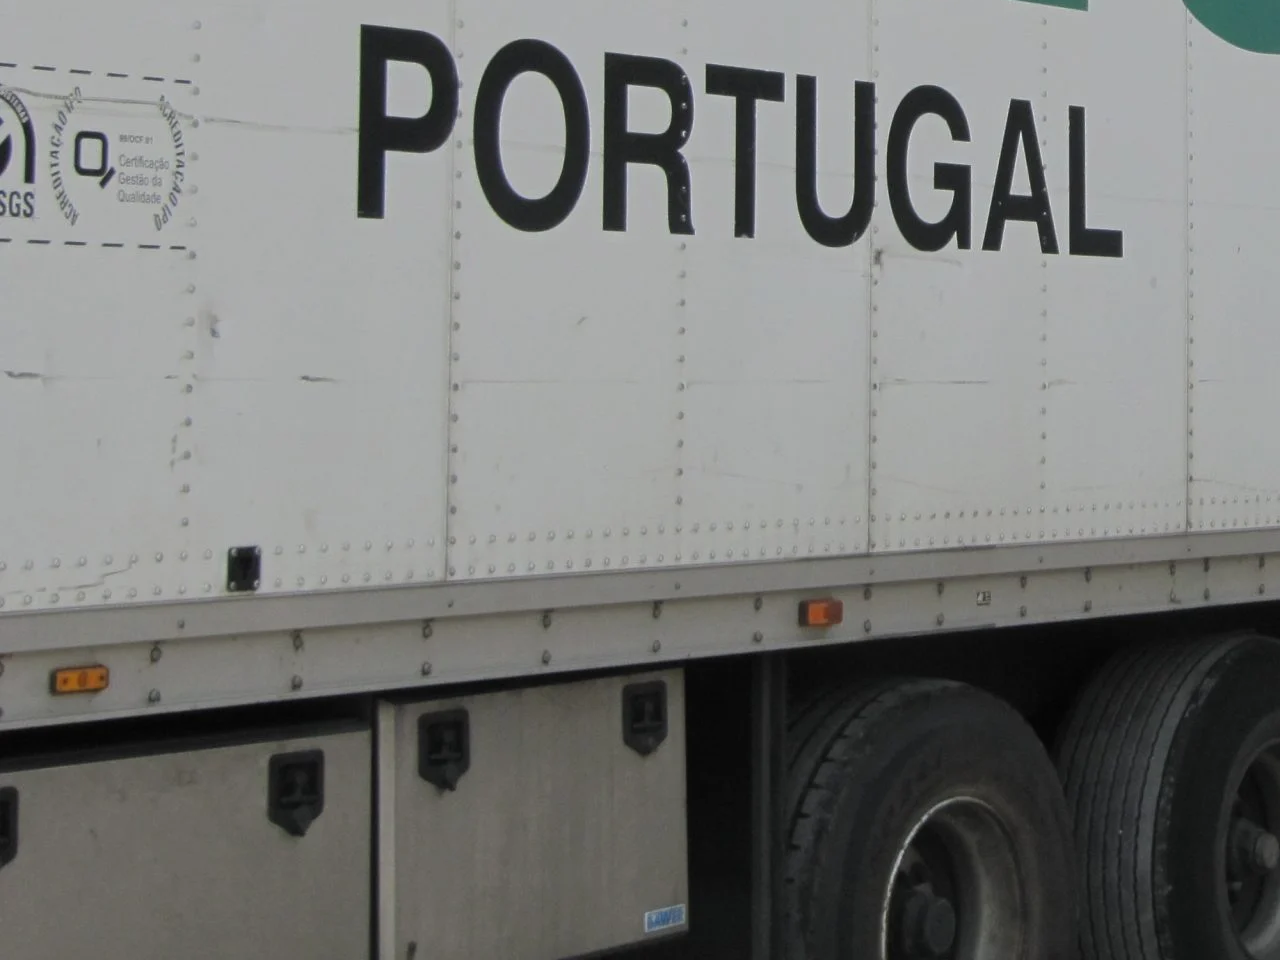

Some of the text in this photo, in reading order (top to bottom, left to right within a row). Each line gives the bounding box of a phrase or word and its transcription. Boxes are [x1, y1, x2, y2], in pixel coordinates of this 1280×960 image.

[358, 24, 1123, 258] PORTUGAL
[118, 153, 170, 172] Certificação
[118, 171, 163, 187] Gestão da
[117, 189, 162, 205] Qualidade
